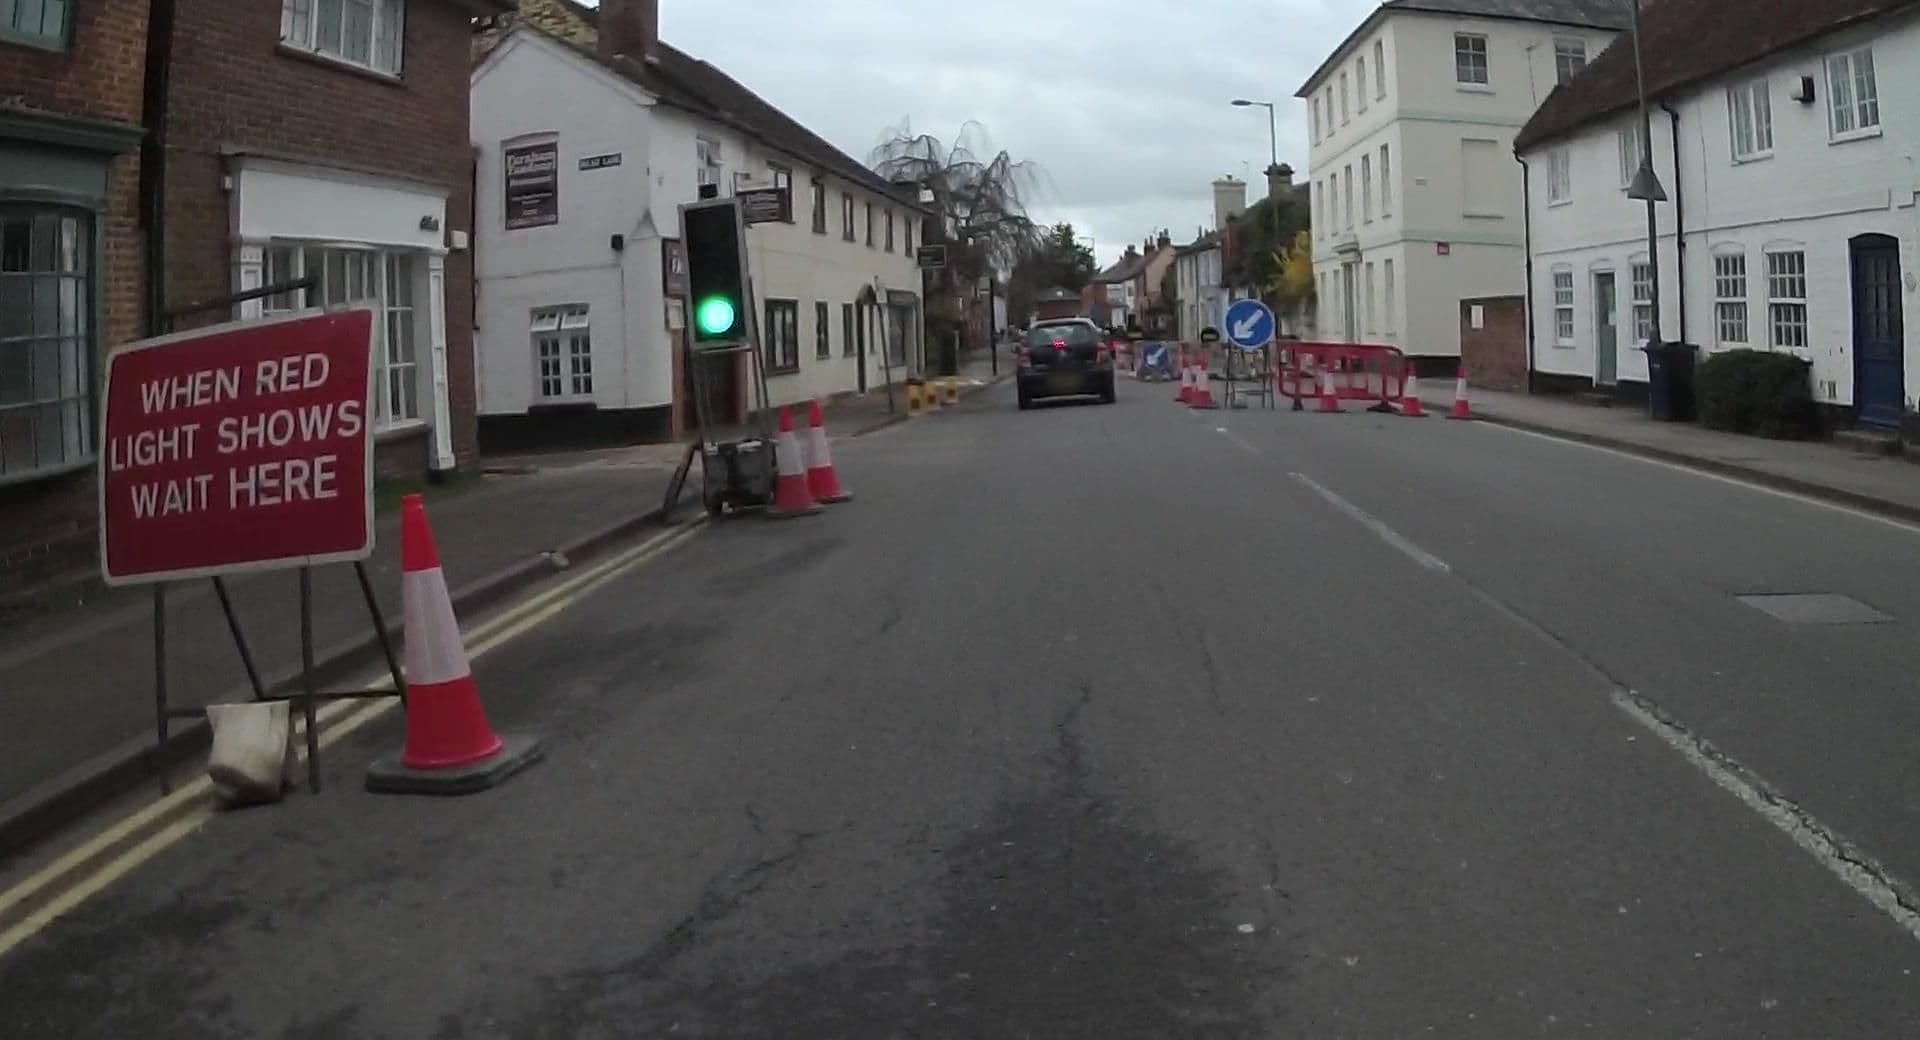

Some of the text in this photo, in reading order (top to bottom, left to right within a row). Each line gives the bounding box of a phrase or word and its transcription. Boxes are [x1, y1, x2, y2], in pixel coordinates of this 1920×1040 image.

[141, 352, 330, 415] WHEN RED
[110, 400, 361, 471] LIGHT SHOWS
[131, 454, 338, 519] WAIT HERE
